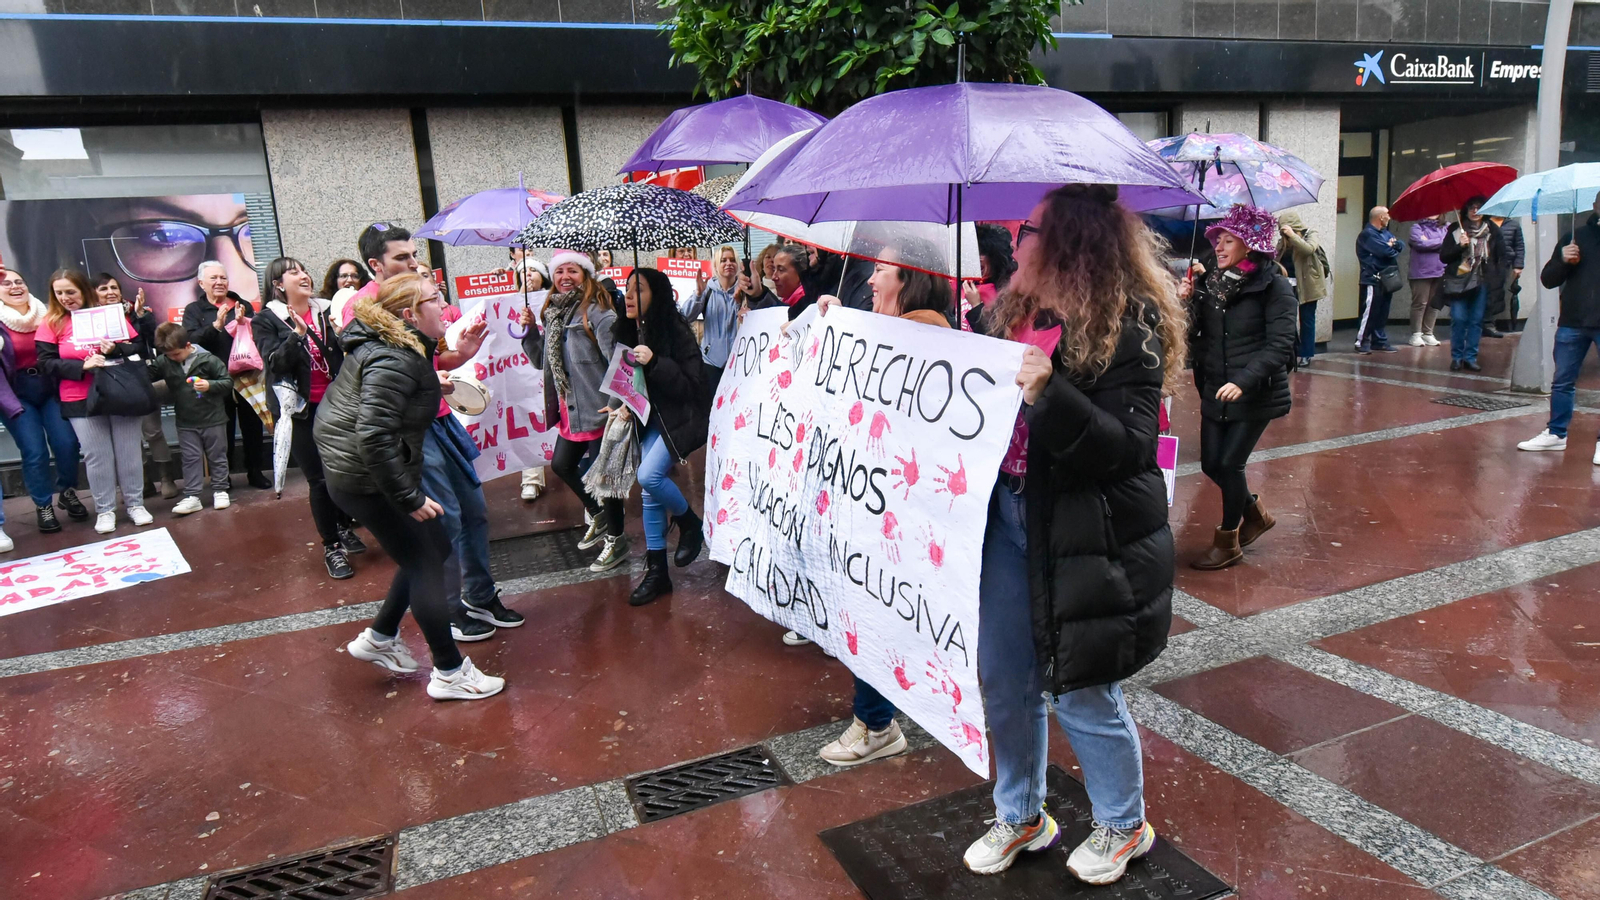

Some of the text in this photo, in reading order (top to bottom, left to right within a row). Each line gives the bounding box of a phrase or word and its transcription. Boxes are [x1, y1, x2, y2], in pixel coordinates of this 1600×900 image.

[1390, 52, 1475, 78] CaixaBank
[668, 259, 702, 269] CCOO
[469, 273, 508, 286] CCOO
[662, 269, 707, 278] enseñana
[464, 285, 516, 296] enseñanza
[814, 325, 996, 440] DERECHOS
